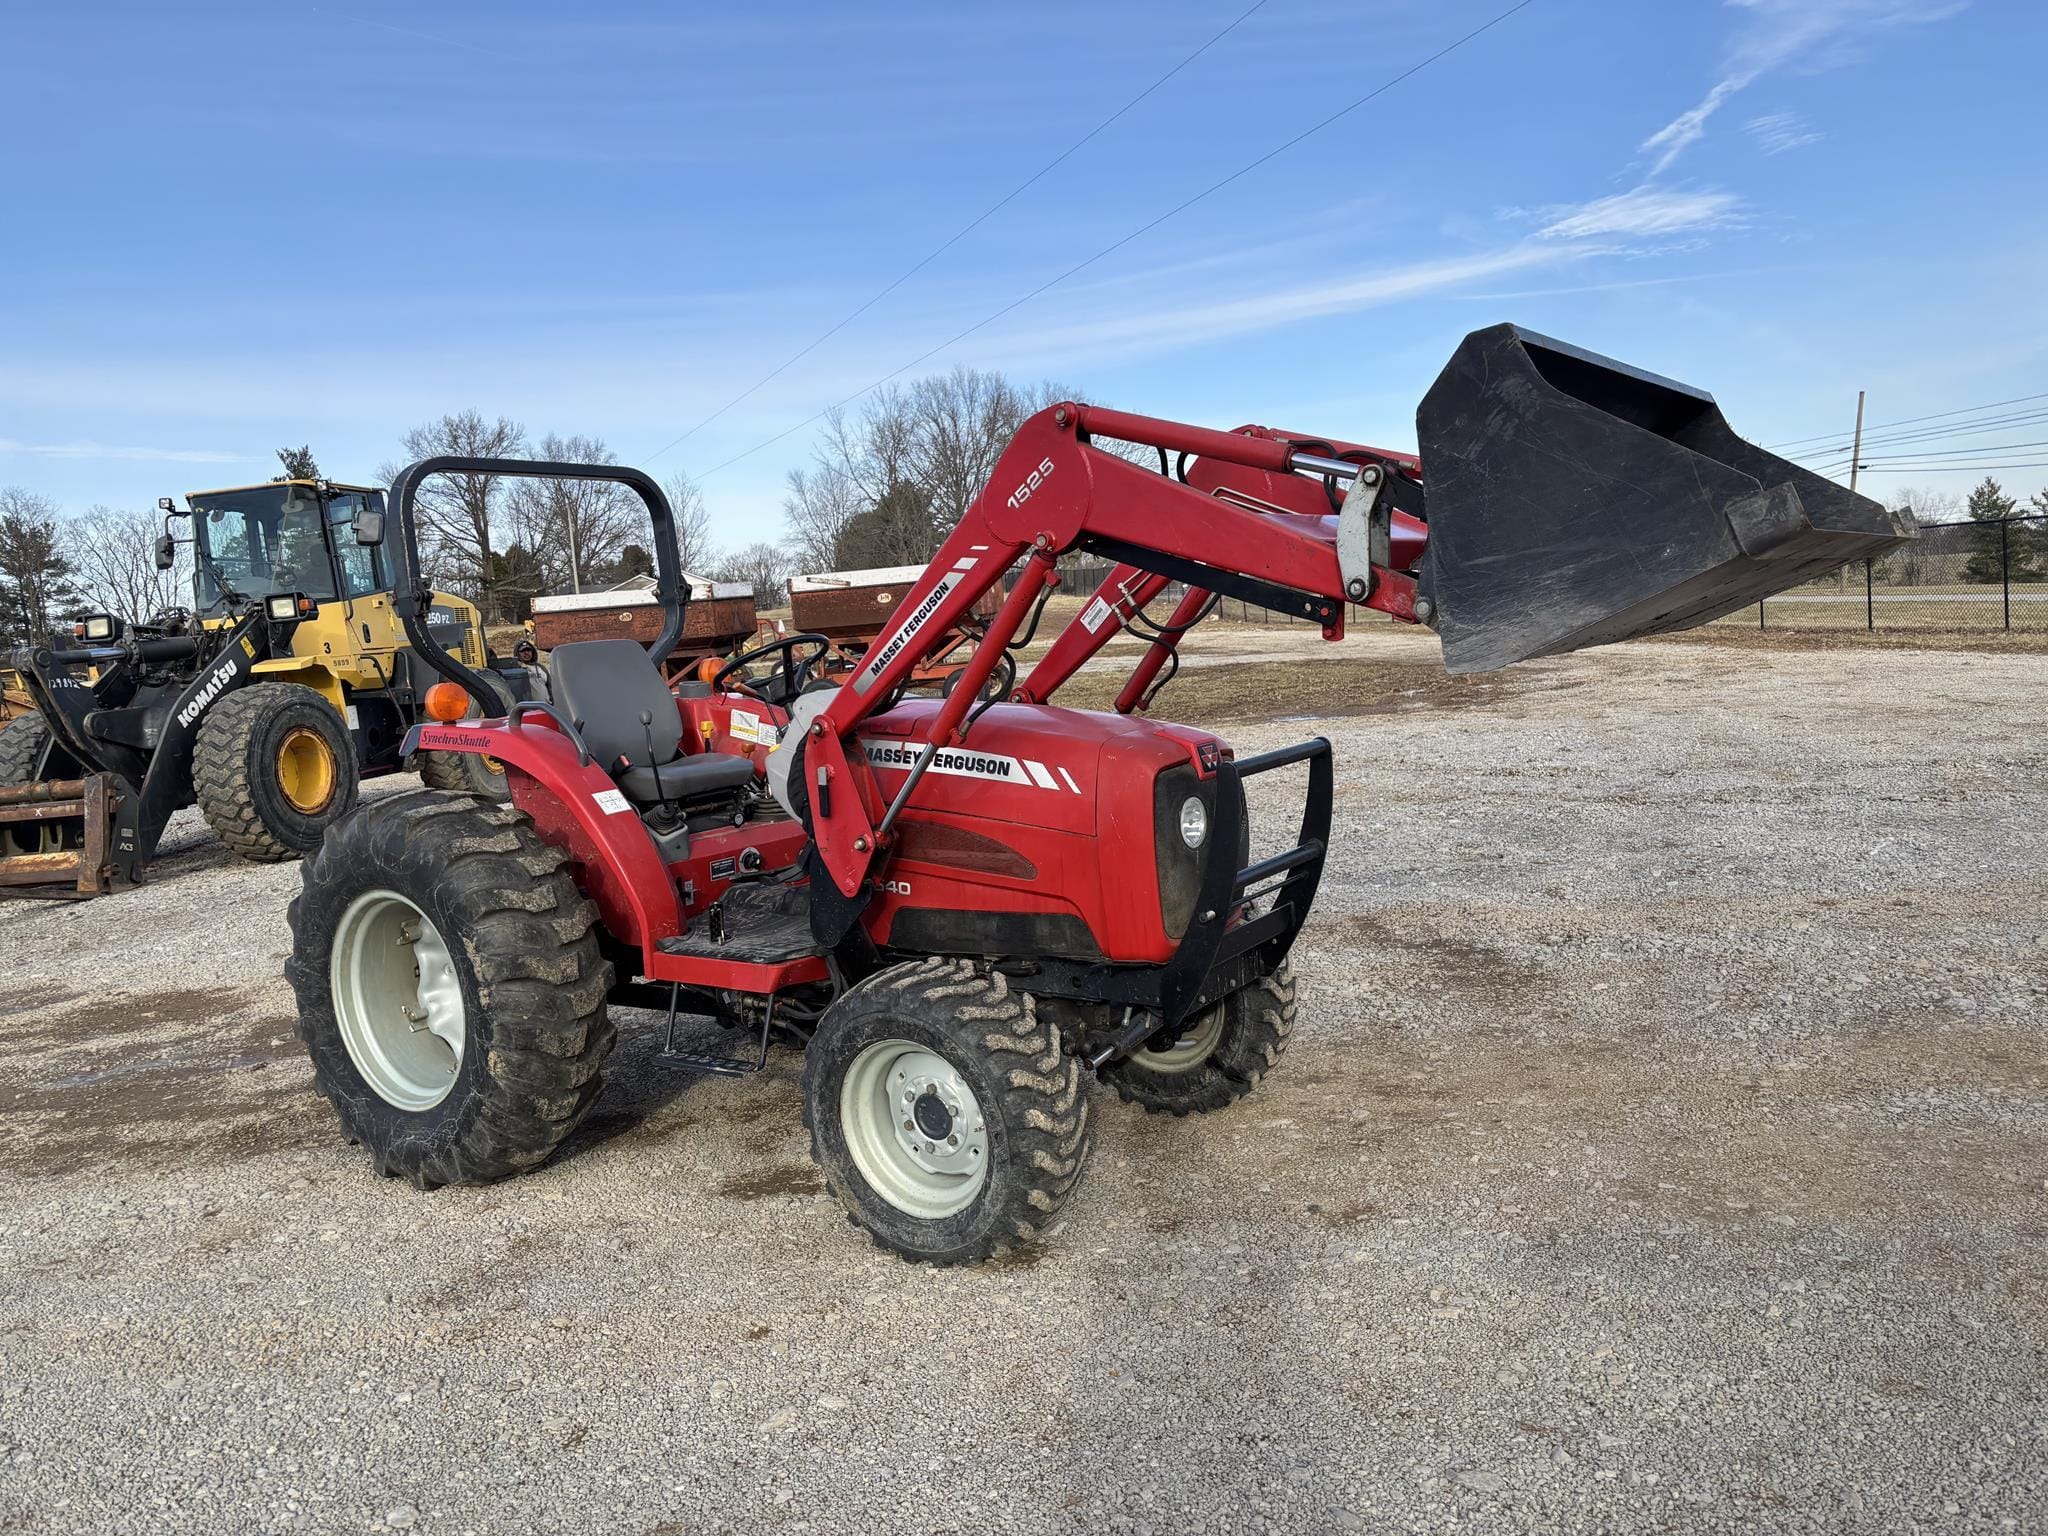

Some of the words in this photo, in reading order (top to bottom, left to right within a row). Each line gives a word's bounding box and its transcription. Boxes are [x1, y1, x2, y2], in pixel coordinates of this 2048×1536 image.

[1008, 457, 1055, 508] 1525
[442, 615, 450, 623] PZ
[870, 634, 907, 676] MASSEY
[904, 581, 950, 637] FERGUSON
[323, 642, 331, 654] 3
[177, 659, 238, 728] KOMATSU
[422, 731, 491, 747] SynchroShuttle
[932, 753, 1010, 776] ERGUSON
[120, 842, 134, 851] ACS
